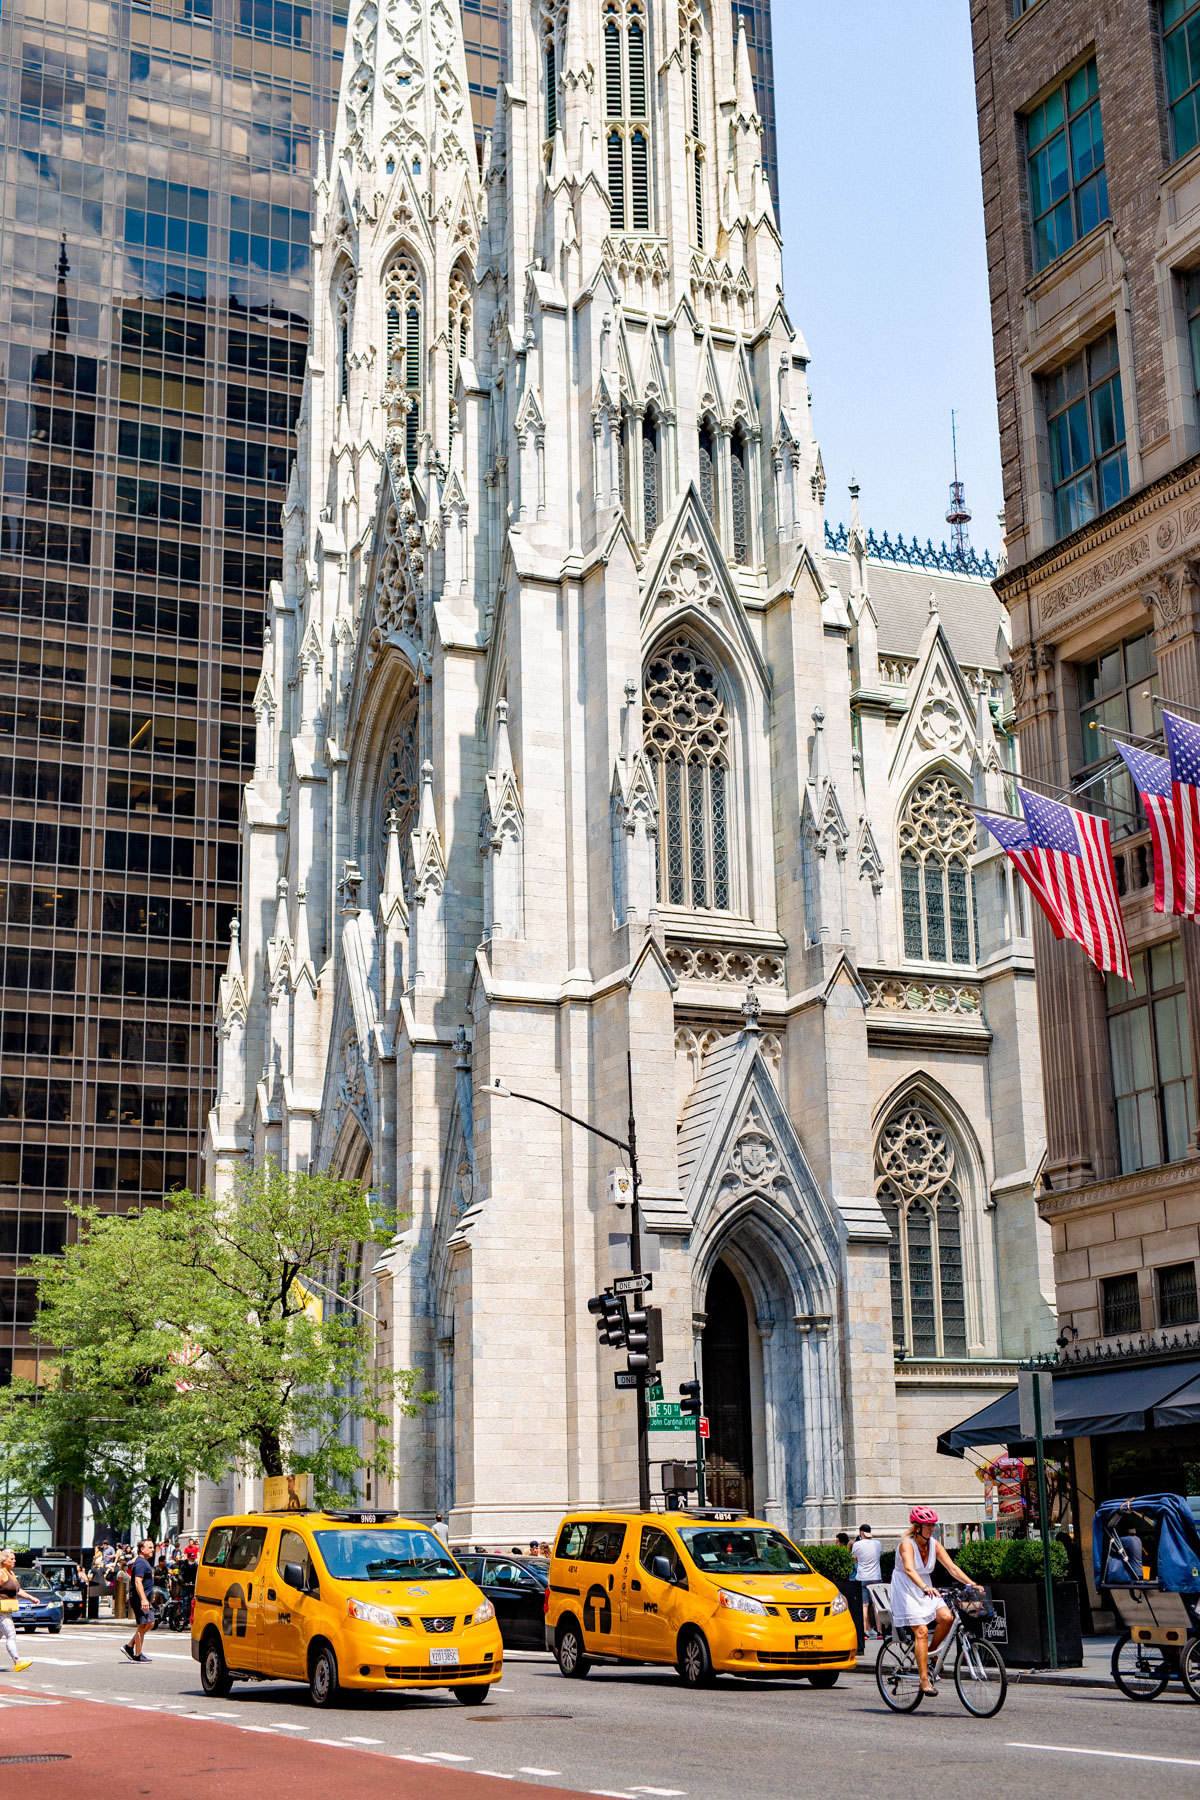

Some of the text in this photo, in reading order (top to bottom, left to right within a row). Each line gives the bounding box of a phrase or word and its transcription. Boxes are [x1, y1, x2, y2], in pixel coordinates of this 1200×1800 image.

[620, 1279, 647, 1290] ONE WAY
[621, 1376, 635, 1384] ONE
[652, 1388, 656, 1400] 5
[656, 1404, 661, 1416] E
[663, 1404, 672, 1416] 50
[651, 1418, 663, 1426] John
[664, 1418, 683, 1426] Cardinal
[360, 1514, 376, 1523] 9N69
[714, 1513, 732, 1521] 4B14
[644, 1602, 658, 1613] NYC
[278, 1612, 291, 1624] NYC
